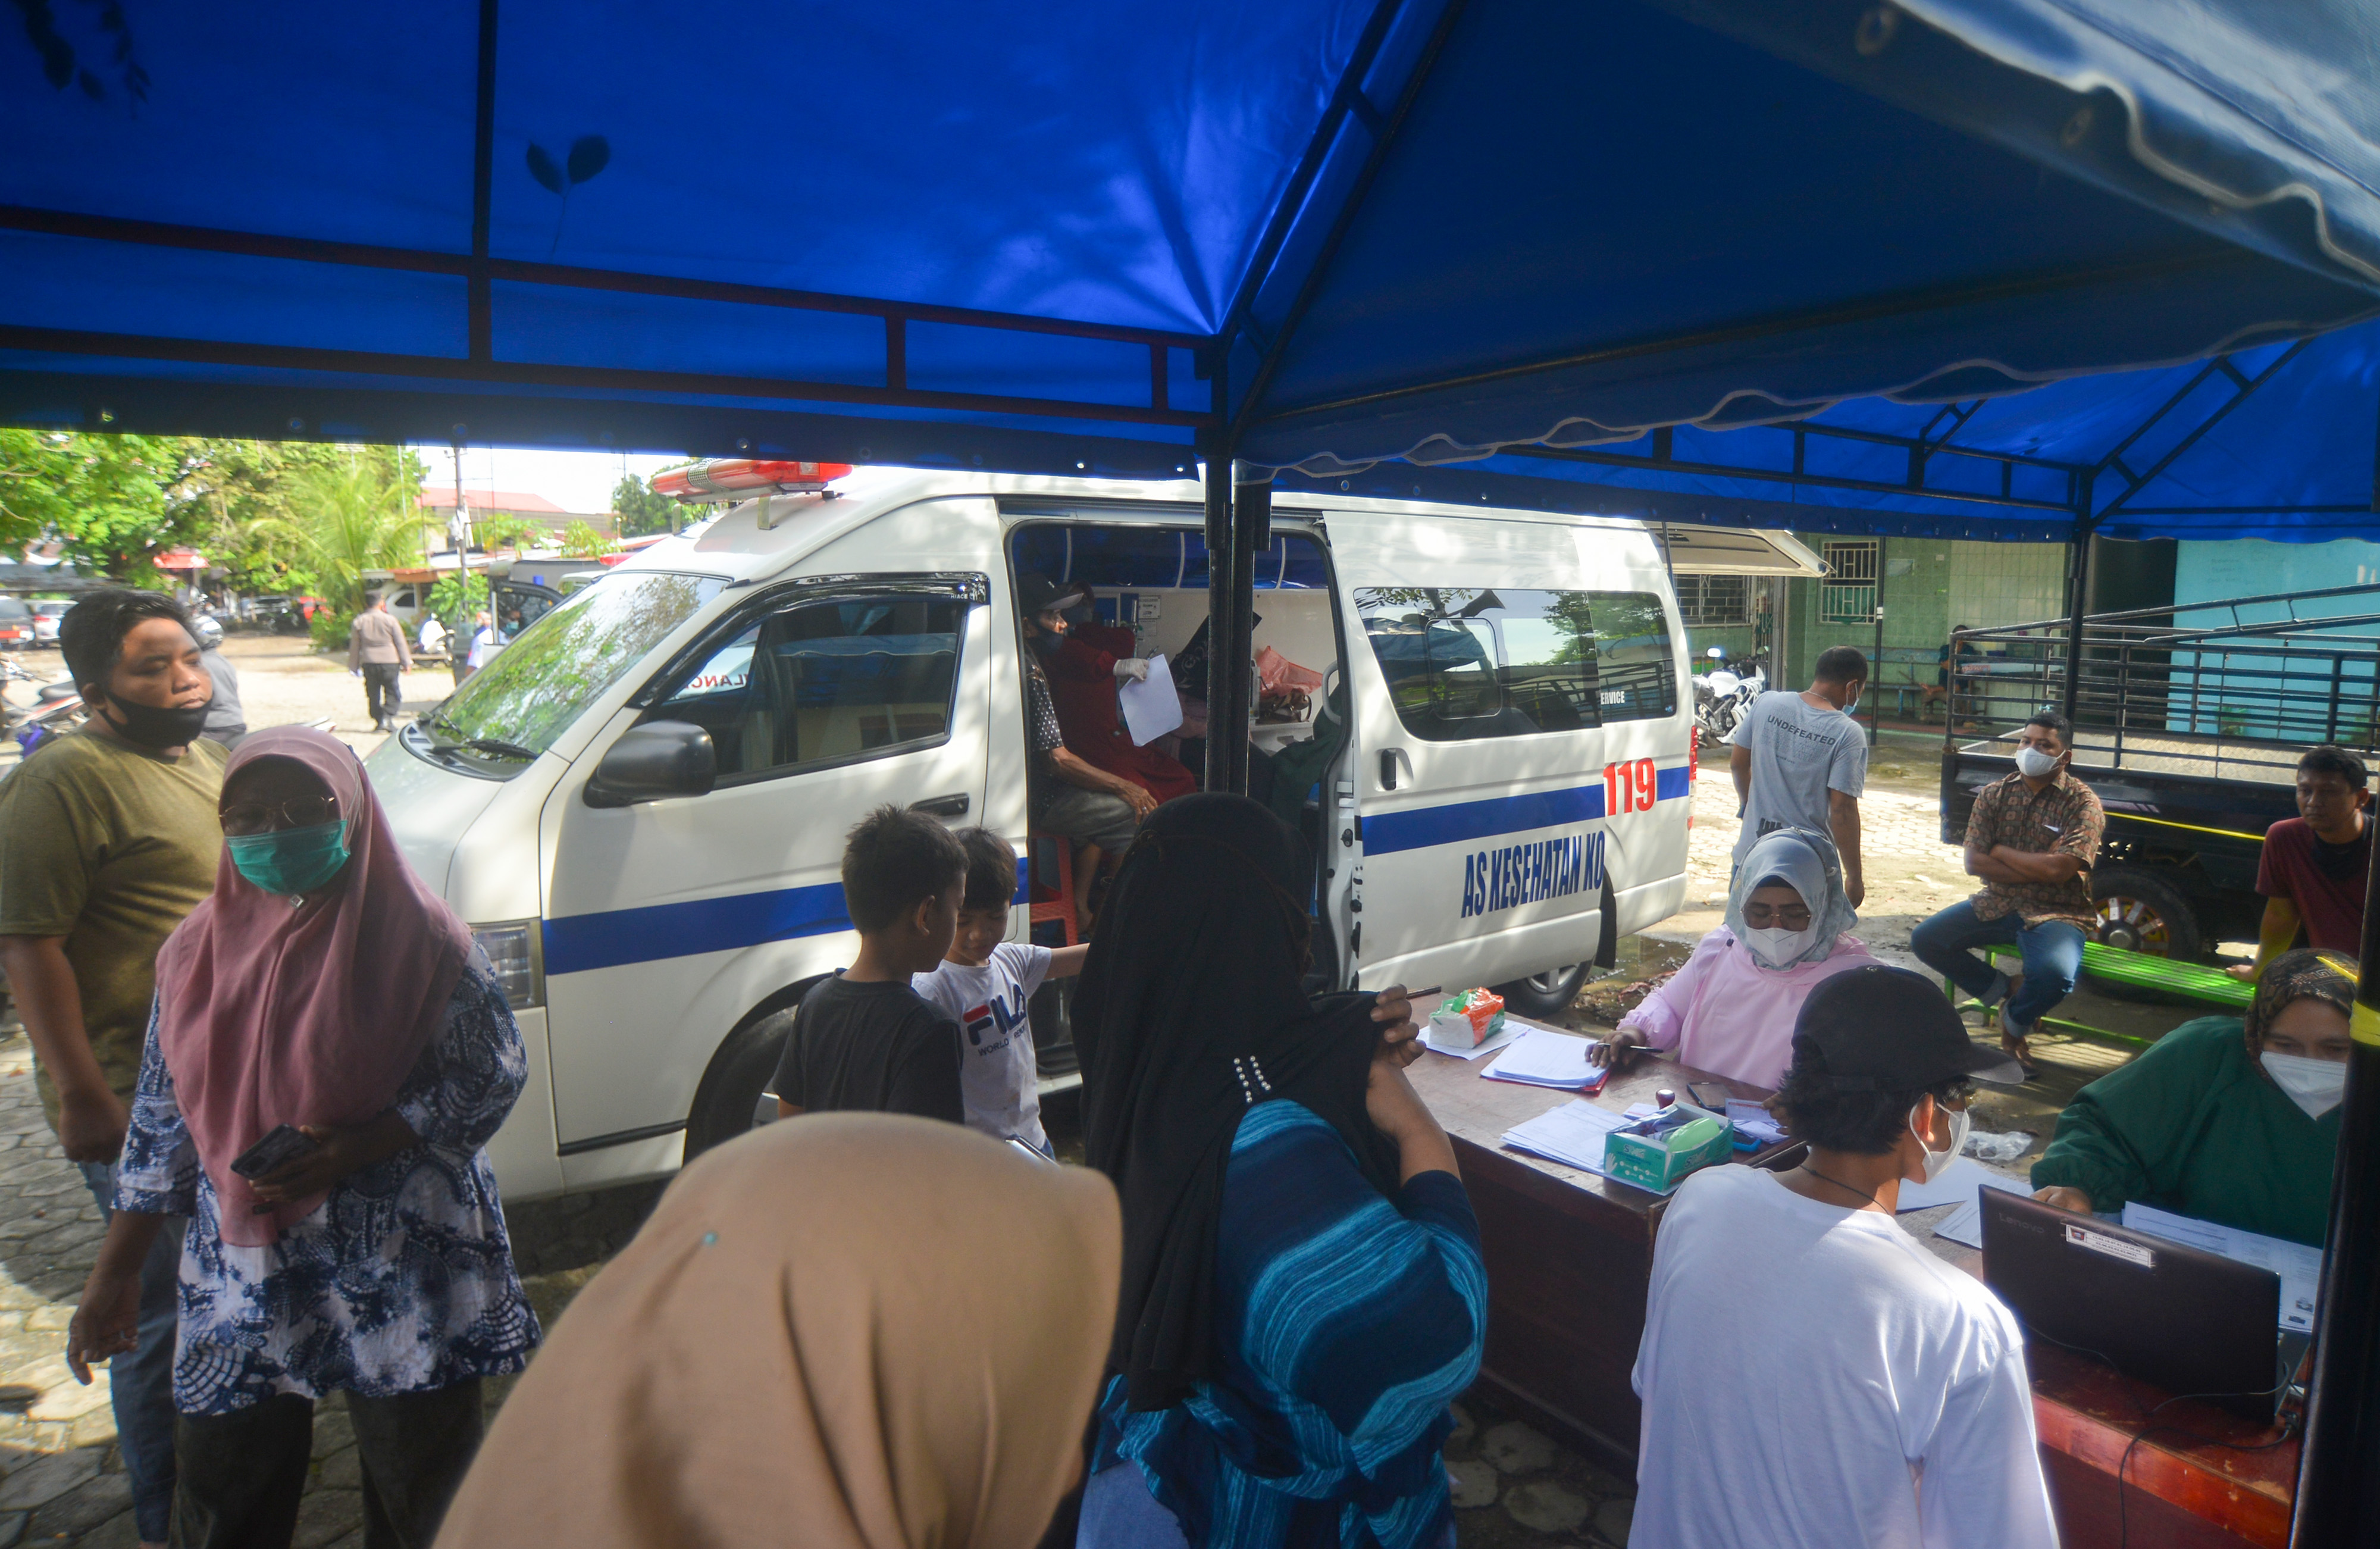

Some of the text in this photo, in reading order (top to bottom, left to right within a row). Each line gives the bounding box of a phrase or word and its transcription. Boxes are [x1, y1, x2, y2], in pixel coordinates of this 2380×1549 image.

[1601, 691, 1625, 705] ERVICE
[1767, 715, 1837, 746] UNDEFEATED
[1603, 757, 1655, 816] 119
[1461, 831, 1605, 918] AS KESEHATAN KO
[963, 984, 1027, 1046] FILA
[978, 1038, 1010, 1056] WORLD
[1999, 1212, 2046, 1234] Lenovo
